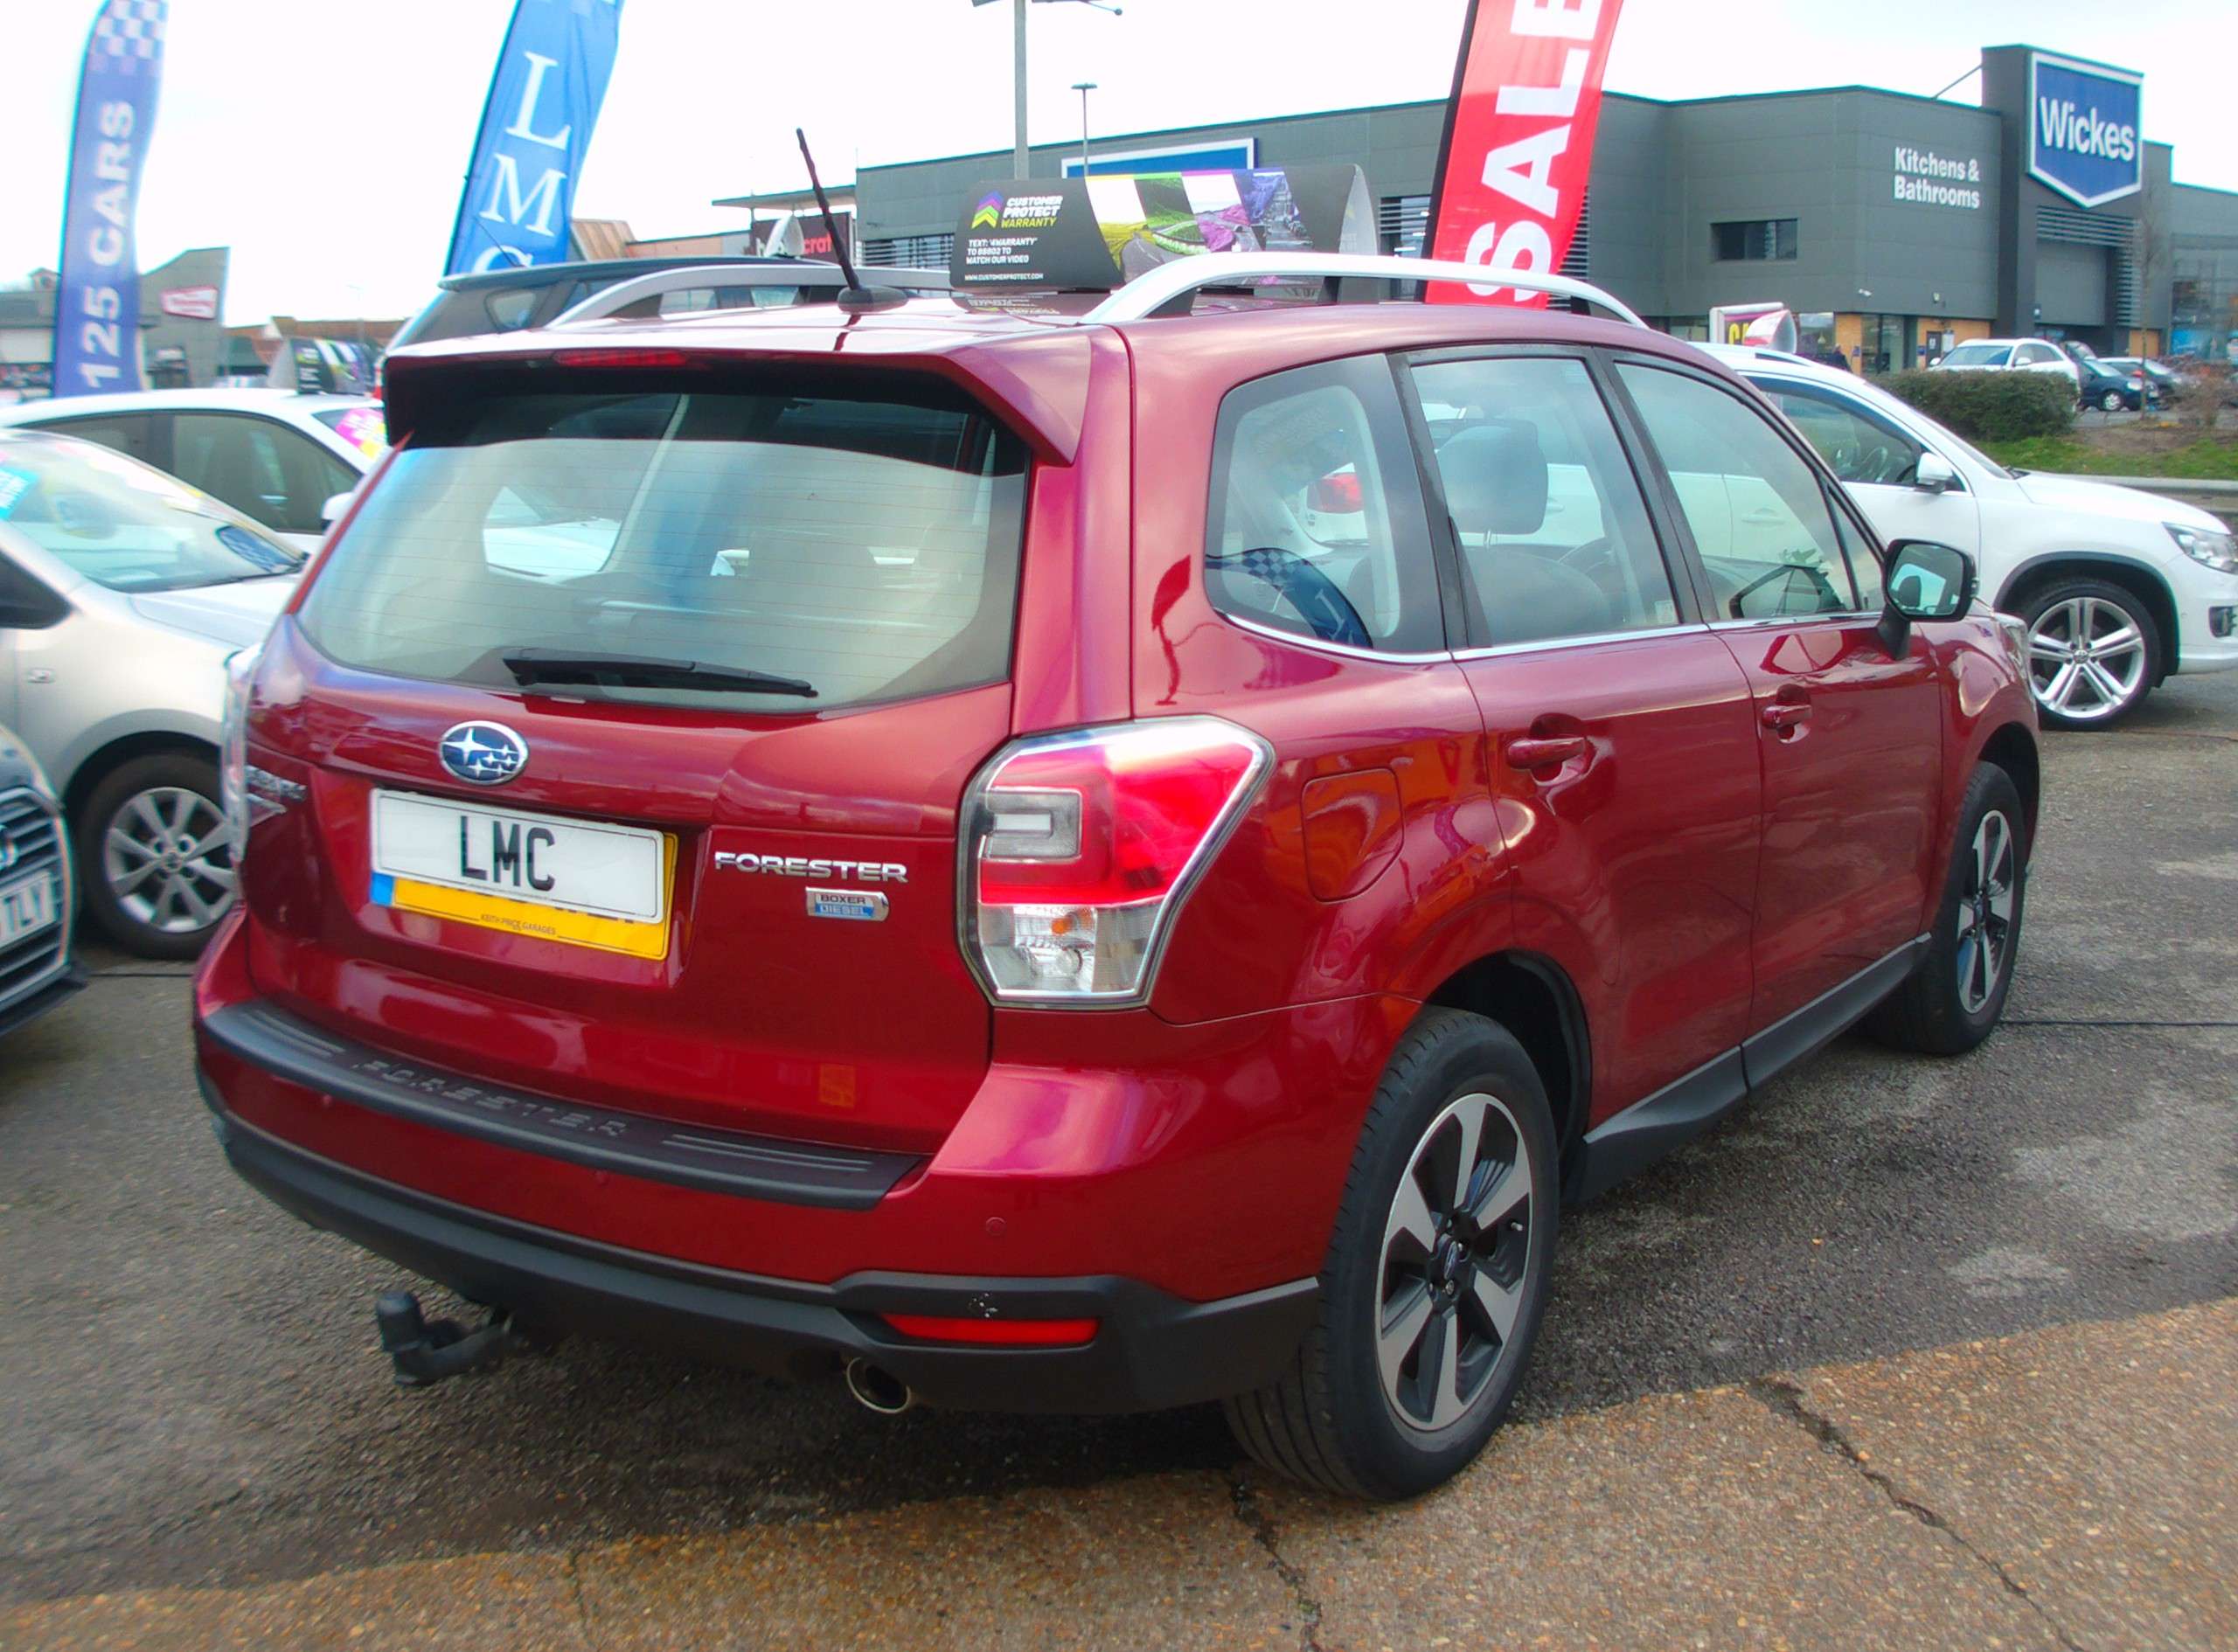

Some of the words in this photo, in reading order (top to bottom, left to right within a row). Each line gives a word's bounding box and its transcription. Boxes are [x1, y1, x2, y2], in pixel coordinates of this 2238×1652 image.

[2040, 96, 2135, 162] Wickes
[1464, 0, 1602, 302] SALE
[1894, 147, 1965, 180] Kitchens
[1967, 158, 1980, 182] &
[89, 99, 136, 266] CARS
[1894, 175, 1980, 209] Bathrooms
[1003, 206, 1060, 218] PROTECT
[1007, 196, 1063, 206] CUSTOMER
[1001, 218, 1056, 228] WARRANTY
[965, 256, 990, 265] WATCH
[991, 255, 1007, 264] OUR
[1008, 254, 1029, 263] VIDEO
[80, 286, 122, 388] 125
[460, 815, 555, 892] LMC
[714, 850, 908, 883] FORESTER
[819, 904, 867, 916] DIESEL
[820, 894, 866, 905] BOXER
[522, 921, 556, 935] GARAGES
